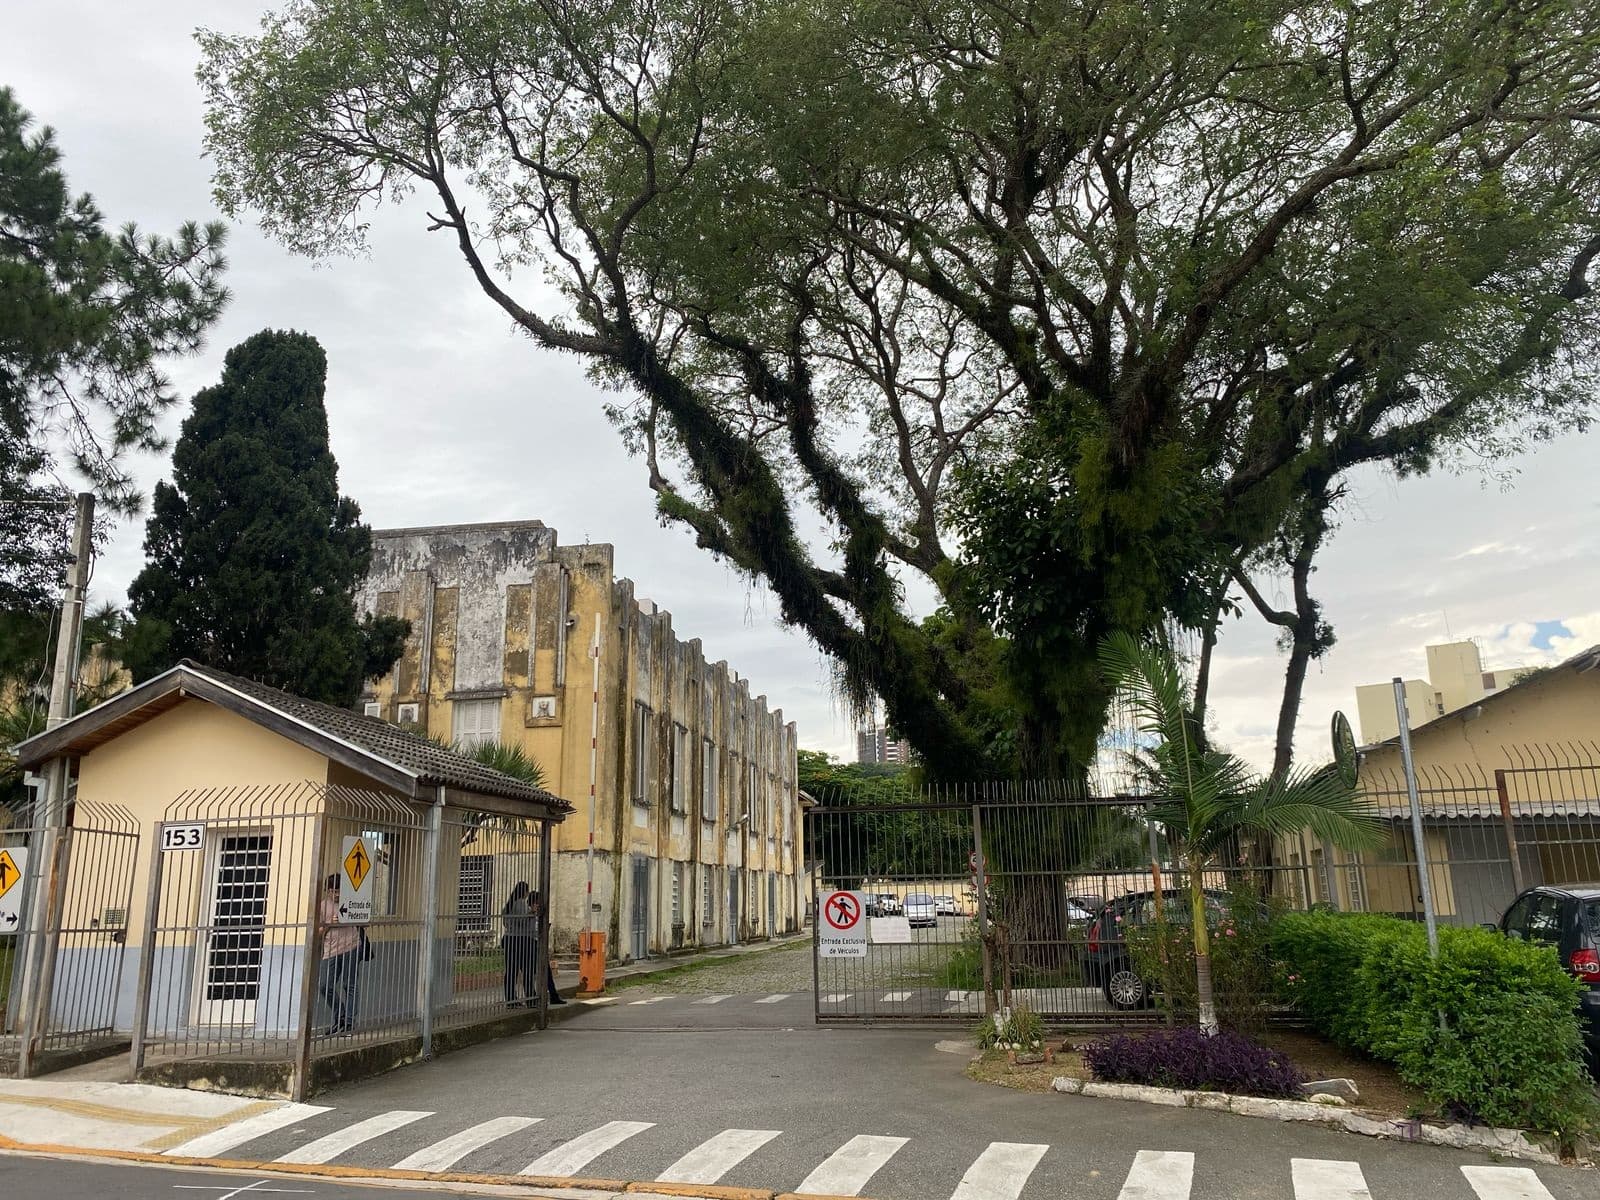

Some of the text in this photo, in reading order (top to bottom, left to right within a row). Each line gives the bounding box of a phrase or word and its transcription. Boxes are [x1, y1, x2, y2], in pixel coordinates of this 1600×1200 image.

[165, 829, 201, 847] 153
[348, 900, 365, 909] Entrada
[821, 937, 866, 945] Entrada Exclusiva
[829, 947, 837, 955] de
